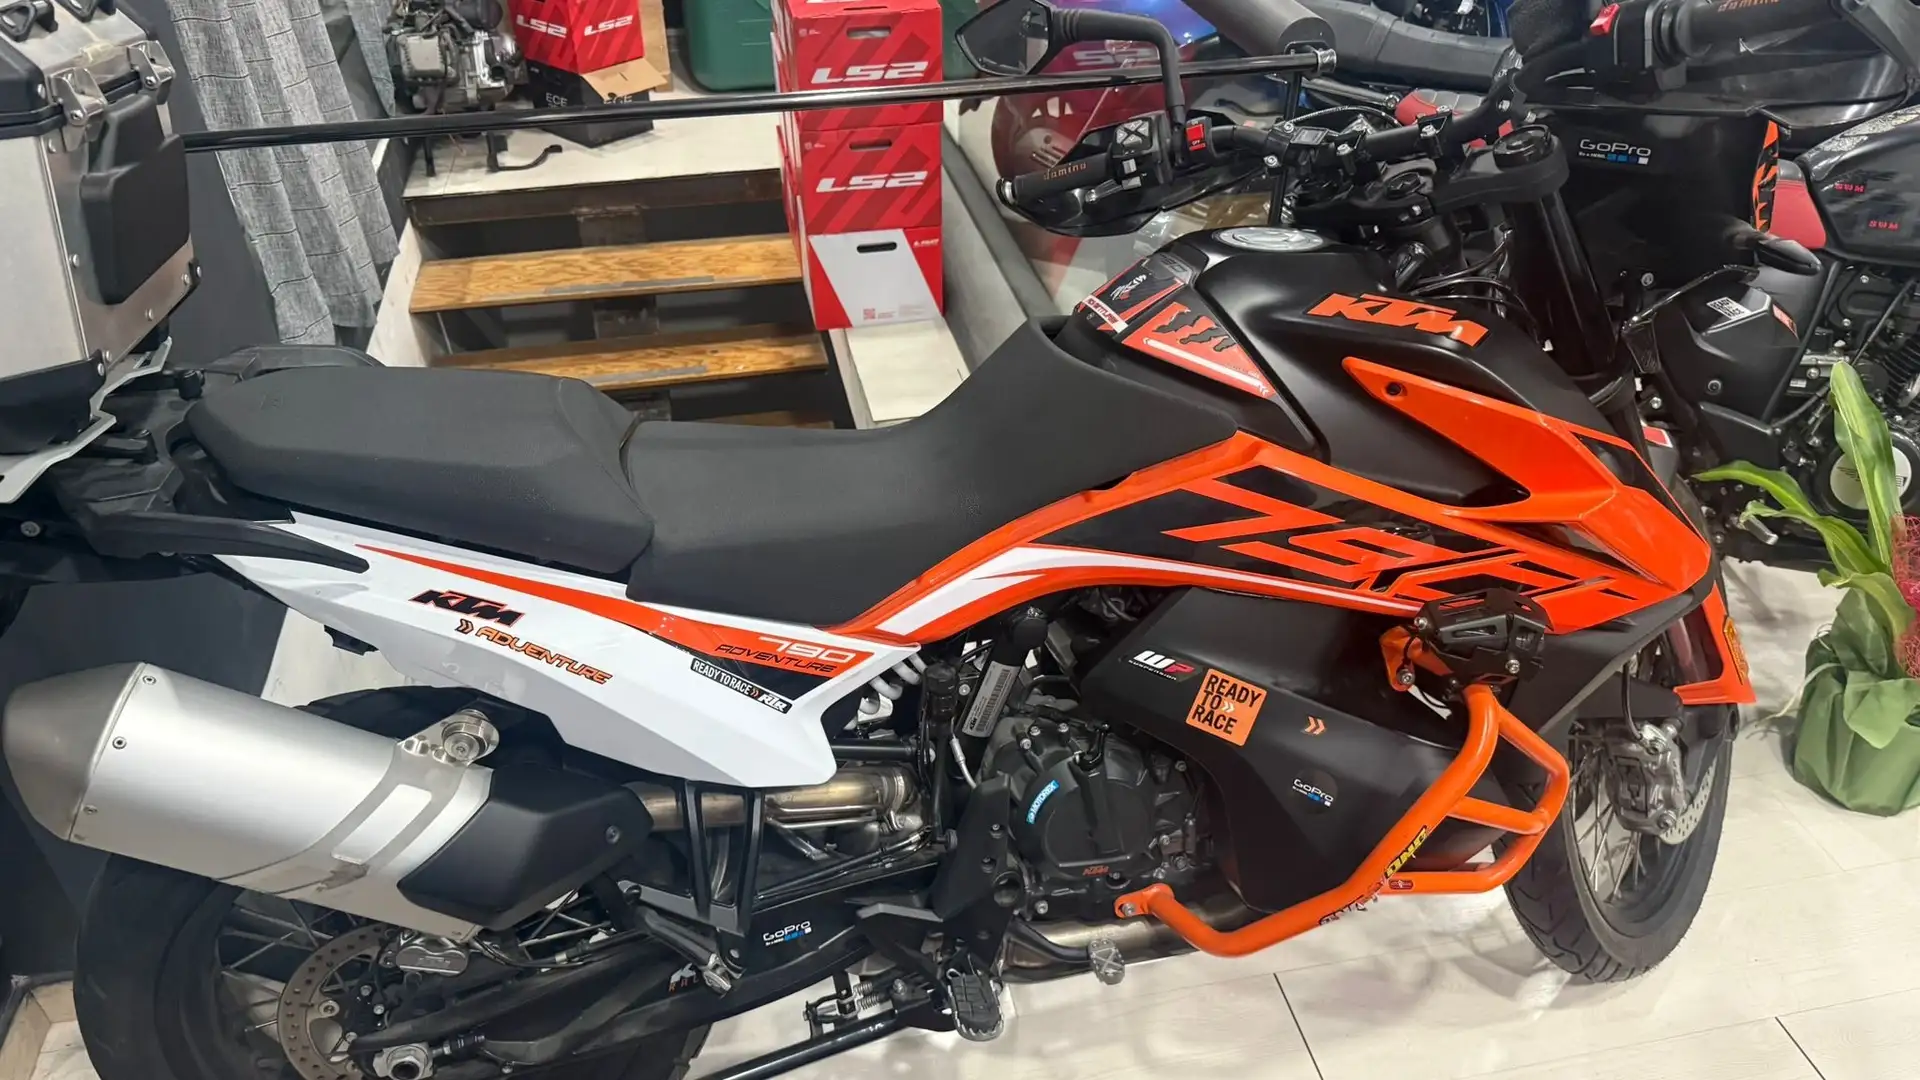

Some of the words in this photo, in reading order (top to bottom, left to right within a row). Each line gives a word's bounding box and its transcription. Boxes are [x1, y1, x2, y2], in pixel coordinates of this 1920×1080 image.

[516, 14, 568, 39] LS2
[583, 14, 634, 37] LS2
[810, 61, 929, 84] LS2
[545, 92, 568, 107] ECE
[1579, 139, 1652, 156] GoPro
[815, 170, 929, 193] LS2
[1305, 292, 1490, 348] KTM
[408, 588, 526, 628] KTM
[474, 625, 614, 685] ADVENTURE
[714, 643, 838, 673] ADVENTURE
[757, 635, 857, 664] 790
[692, 660, 721, 680] READY
[719, 672, 732, 685] TO
[728, 678, 753, 695] RACE
[1200, 689, 1223, 711] TO
[1204, 674, 1263, 708] READY
[1191, 704, 1239, 735] RACE
[1293, 778, 1334, 802] GoPro
[1082, 865, 1110, 876] KTM
[762, 920, 811, 942] GoPro
